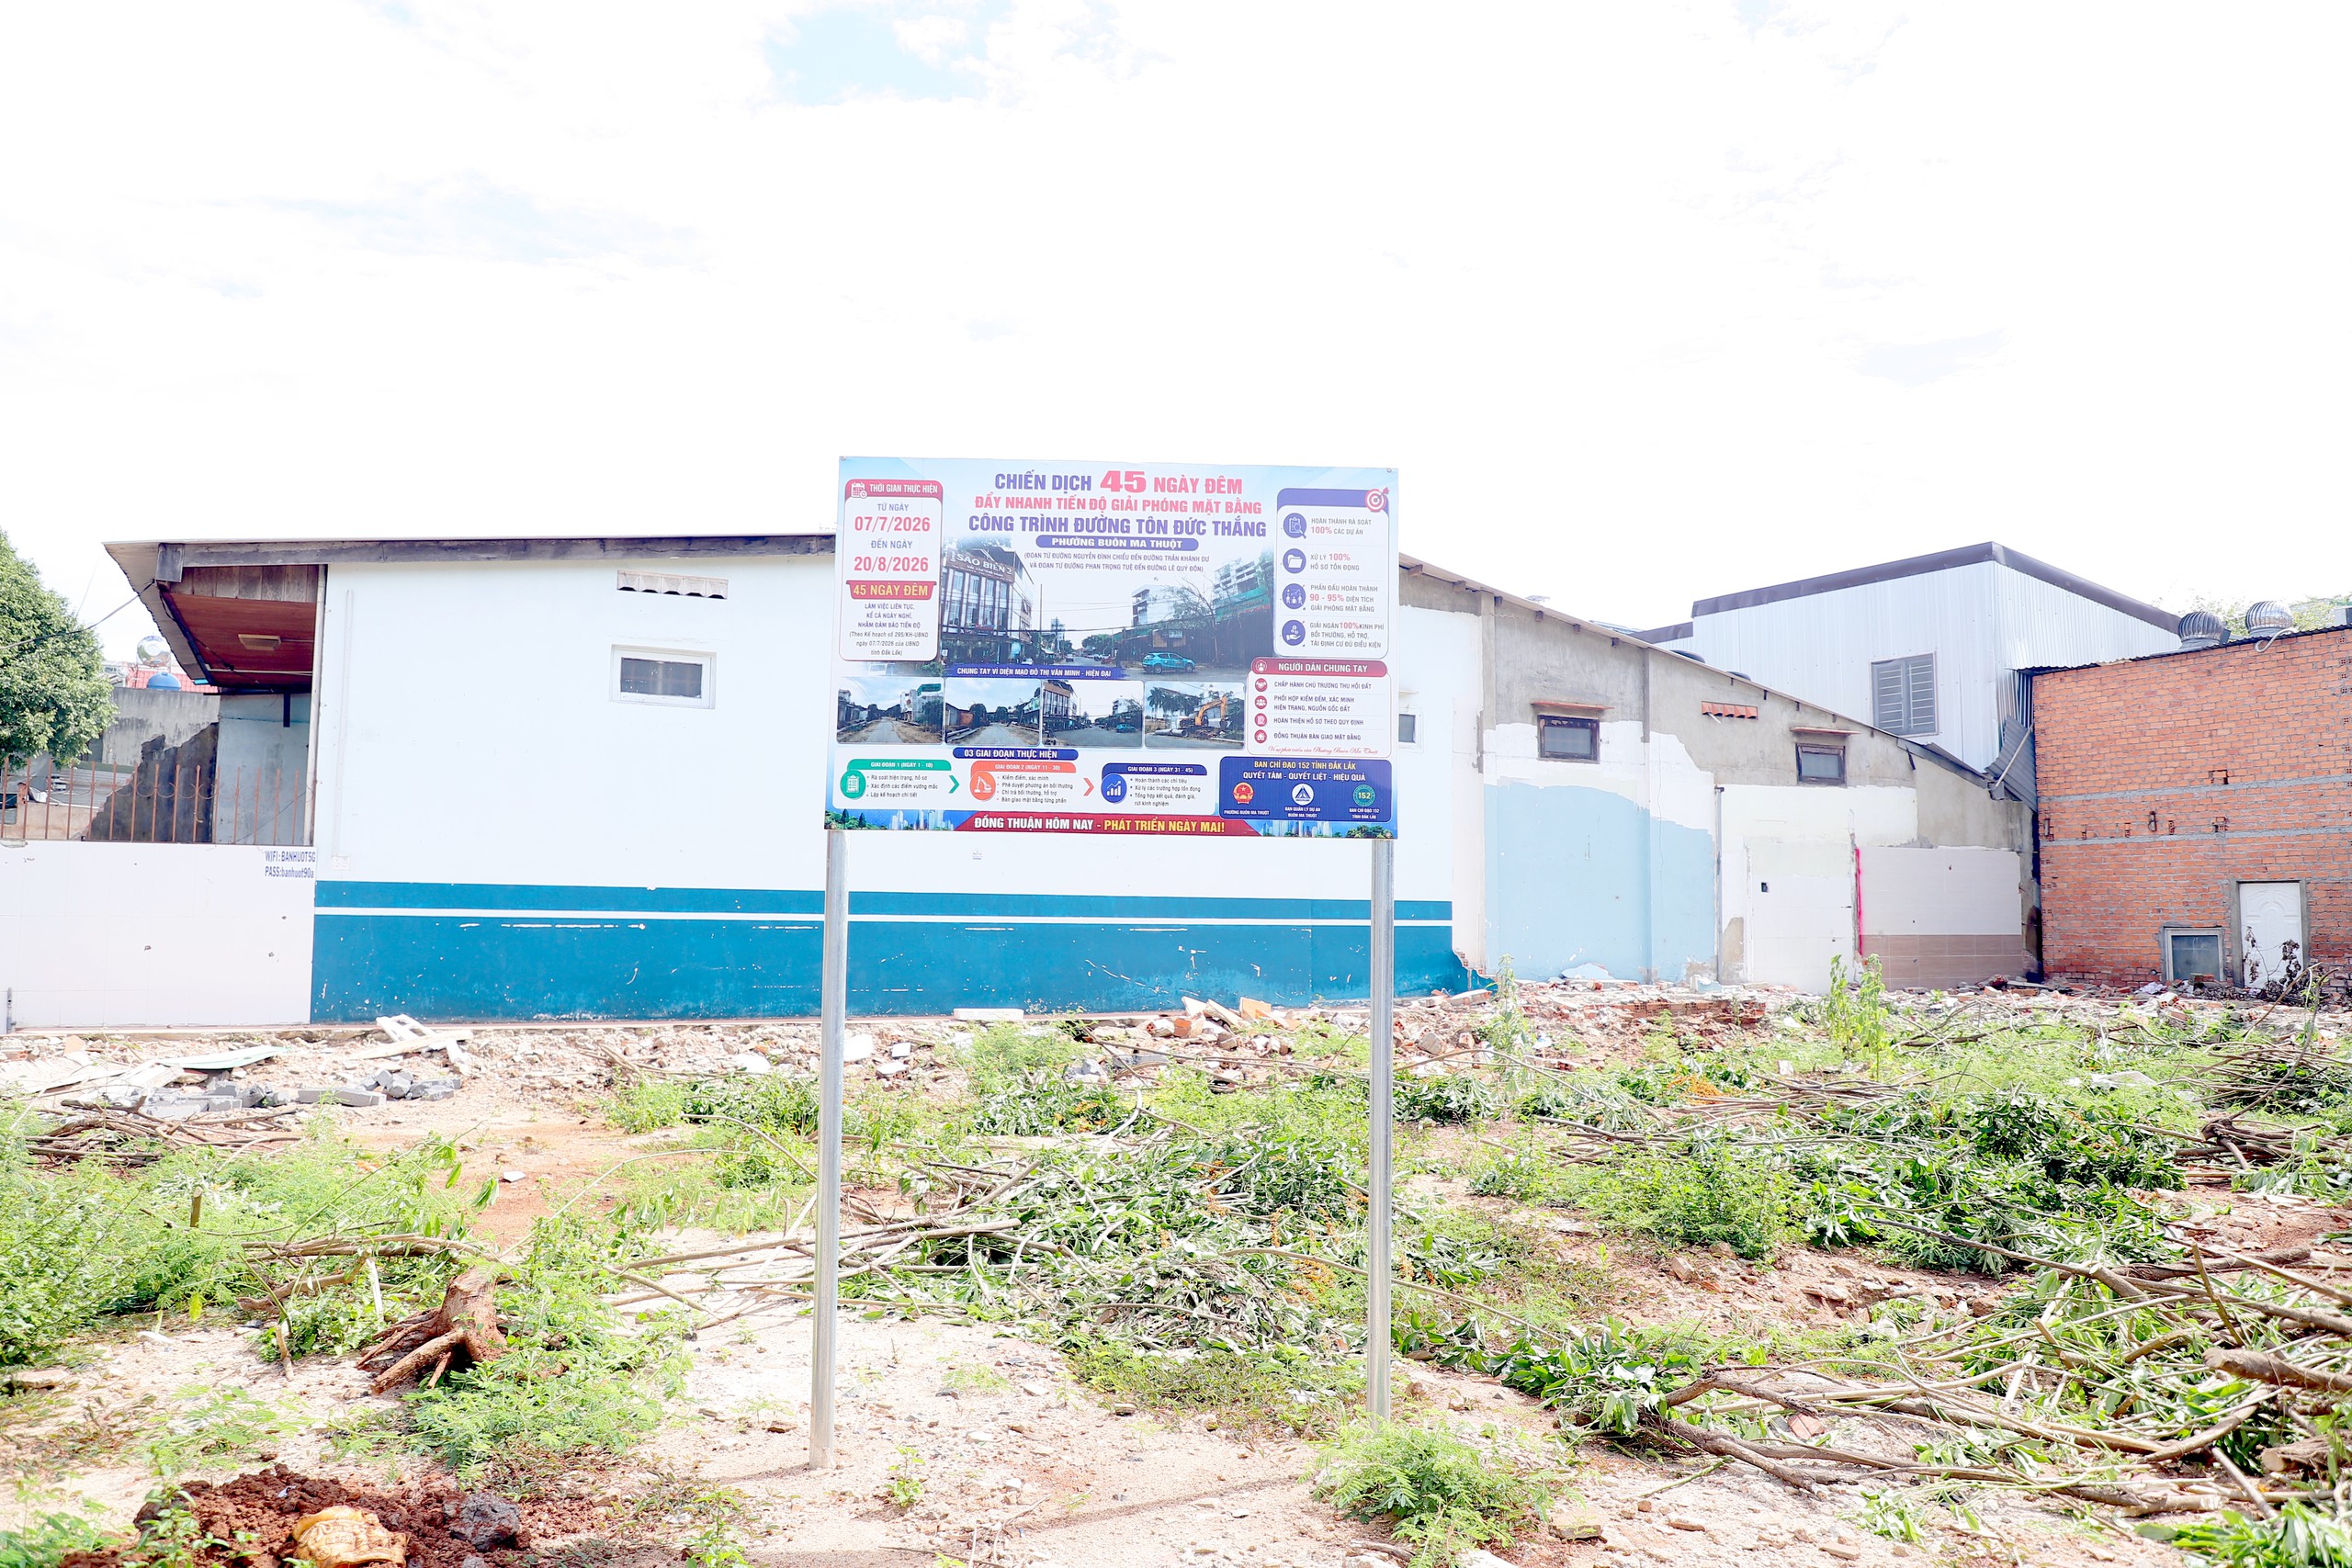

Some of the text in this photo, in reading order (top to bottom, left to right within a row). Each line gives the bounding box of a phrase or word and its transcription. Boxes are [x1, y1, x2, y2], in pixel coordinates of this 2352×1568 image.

[995, 469, 1242, 494] CHIẾN DỊCH 45 NGÀY ĐÊM
[870, 483, 938, 494] THỜI GIAN THỰC HIỆN
[889, 502, 909, 512] NGÀY
[975, 491, 1261, 515] ĐẨY NHANH TIẾN ĐỘ GIẢI PHÓNG MẶT BẰNG
[854, 516, 930, 533] 07/7/2026
[969, 513, 1266, 537] CÔNG TRÌNH ĐƯỜNG TÔN ĐỨC THẮNG
[871, 538, 912, 548] ĐẾN NGÀY
[1052, 538, 1094, 547] PHƯỜNG
[1098, 537, 1129, 547] BUÔN
[1150, 540, 1182, 550] THUỘT
[854, 557, 929, 572] 20/8/2026
[956, 554, 980, 566] SAO
[854, 582, 928, 596] 45 NGÀY ĐÊM
[1278, 662, 1303, 671] NGƯỜI
[1306, 662, 1321, 672] DÂN
[1324, 664, 1351, 672] CHUNG
[993, 750, 1014, 759] ĐOẠN
[1017, 750, 1036, 760] THỰC
[1040, 749, 1057, 761] HIỆN
[974, 814, 1003, 829] ĐỒNG
[1007, 818, 1042, 830] THUẬN
[1046, 817, 1071, 829] HÔM
[1073, 819, 1093, 830] NAY
[1104, 818, 1131, 830] PHÁT
[1135, 817, 1165, 831] TRIỂN
[1169, 818, 1197, 832] NGÀY
[1200, 821, 1225, 832] MAI!
